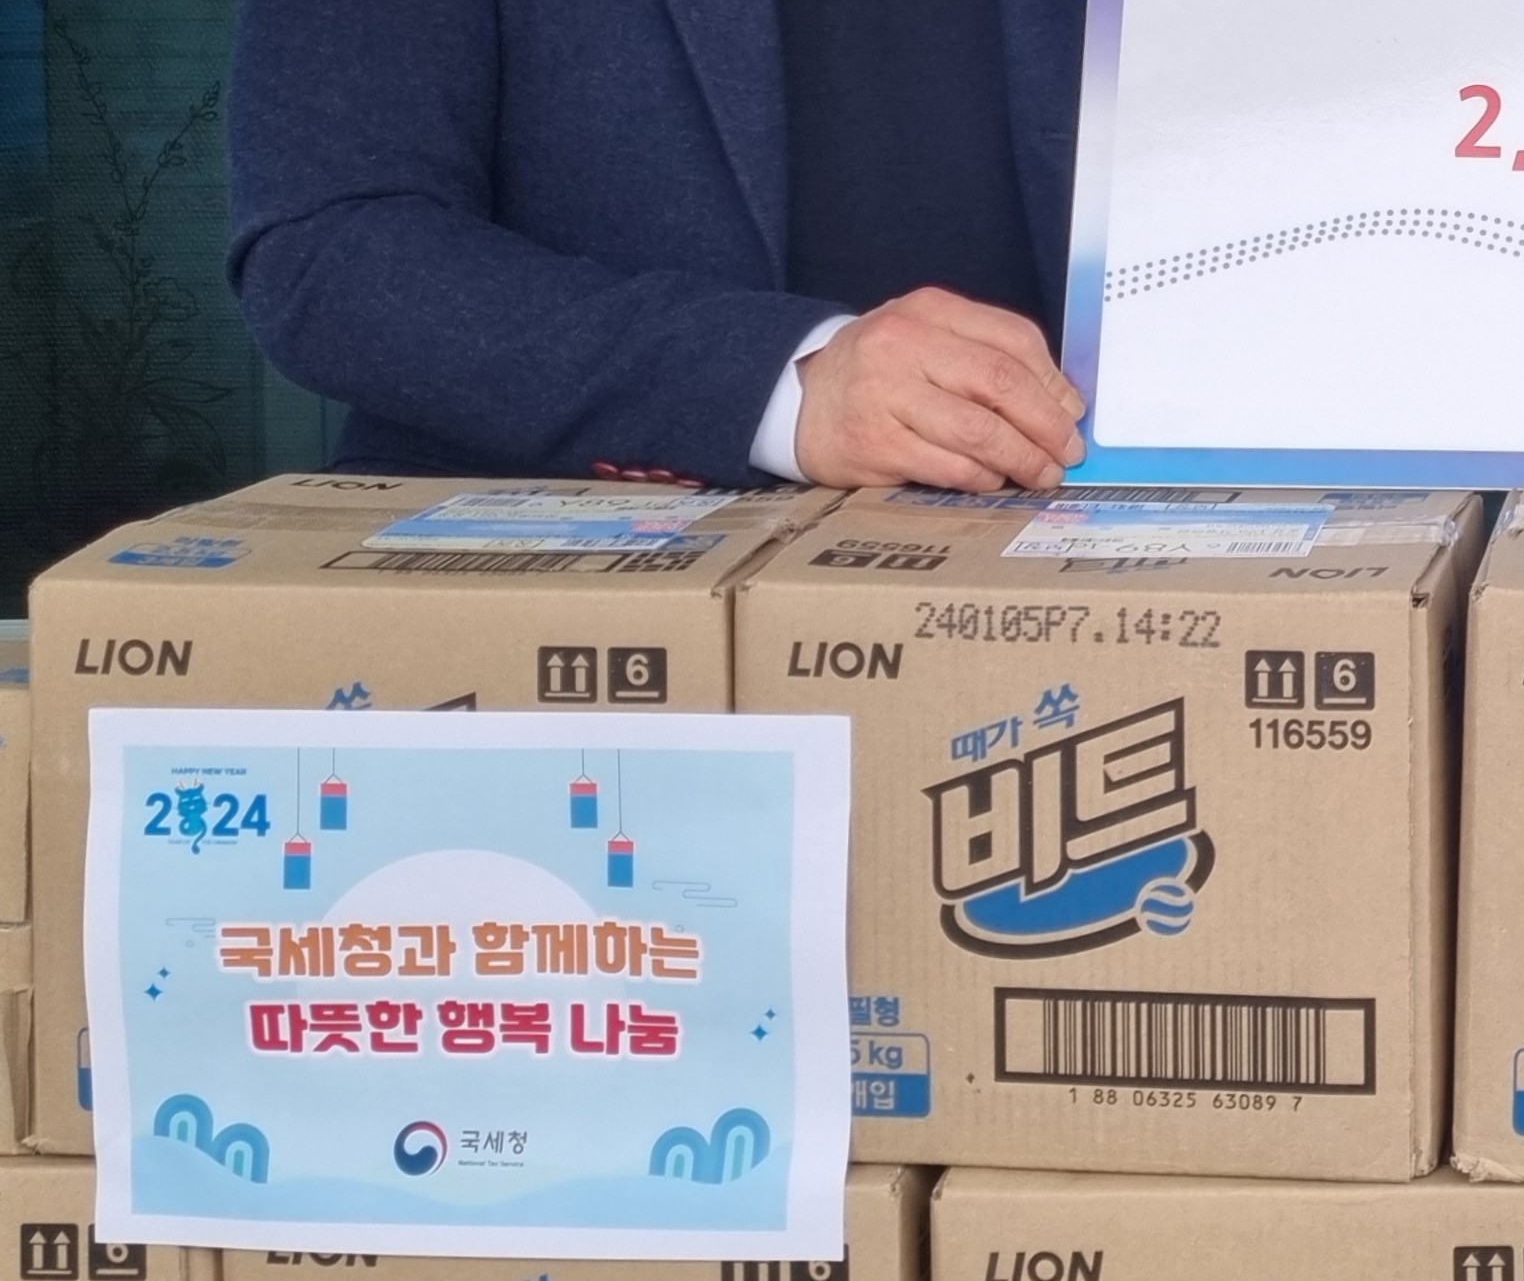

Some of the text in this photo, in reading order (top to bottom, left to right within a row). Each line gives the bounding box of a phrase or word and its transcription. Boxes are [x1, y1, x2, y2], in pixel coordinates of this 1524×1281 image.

[290, 479, 404, 491] LION
[1268, 567, 1391, 580] LION
[913, 602, 1222, 649] 240105P7.14:22
[74, 638, 194, 677] LION
[623, 653, 648, 685] 6
[787, 641, 904, 680] LION
[1332, 659, 1357, 692] 6
[950, 683, 1081, 763] 때가 쏙
[1248, 718, 1373, 751] 116559
[171, 767, 247, 776] HAPPY NEW YEAR
[921, 696, 1198, 900] 비트
[219, 921, 700, 981] 국세청과 함께하는
[249, 1001, 681, 1057] 따뜻한 행복 나눔
[868, 1040, 903, 1070] kg
[1069, 1086, 1304, 1113] 1 88 06325 63089 7
[460, 1129, 528, 1155] 국세청
[985, 1251, 1104, 1281] LION
